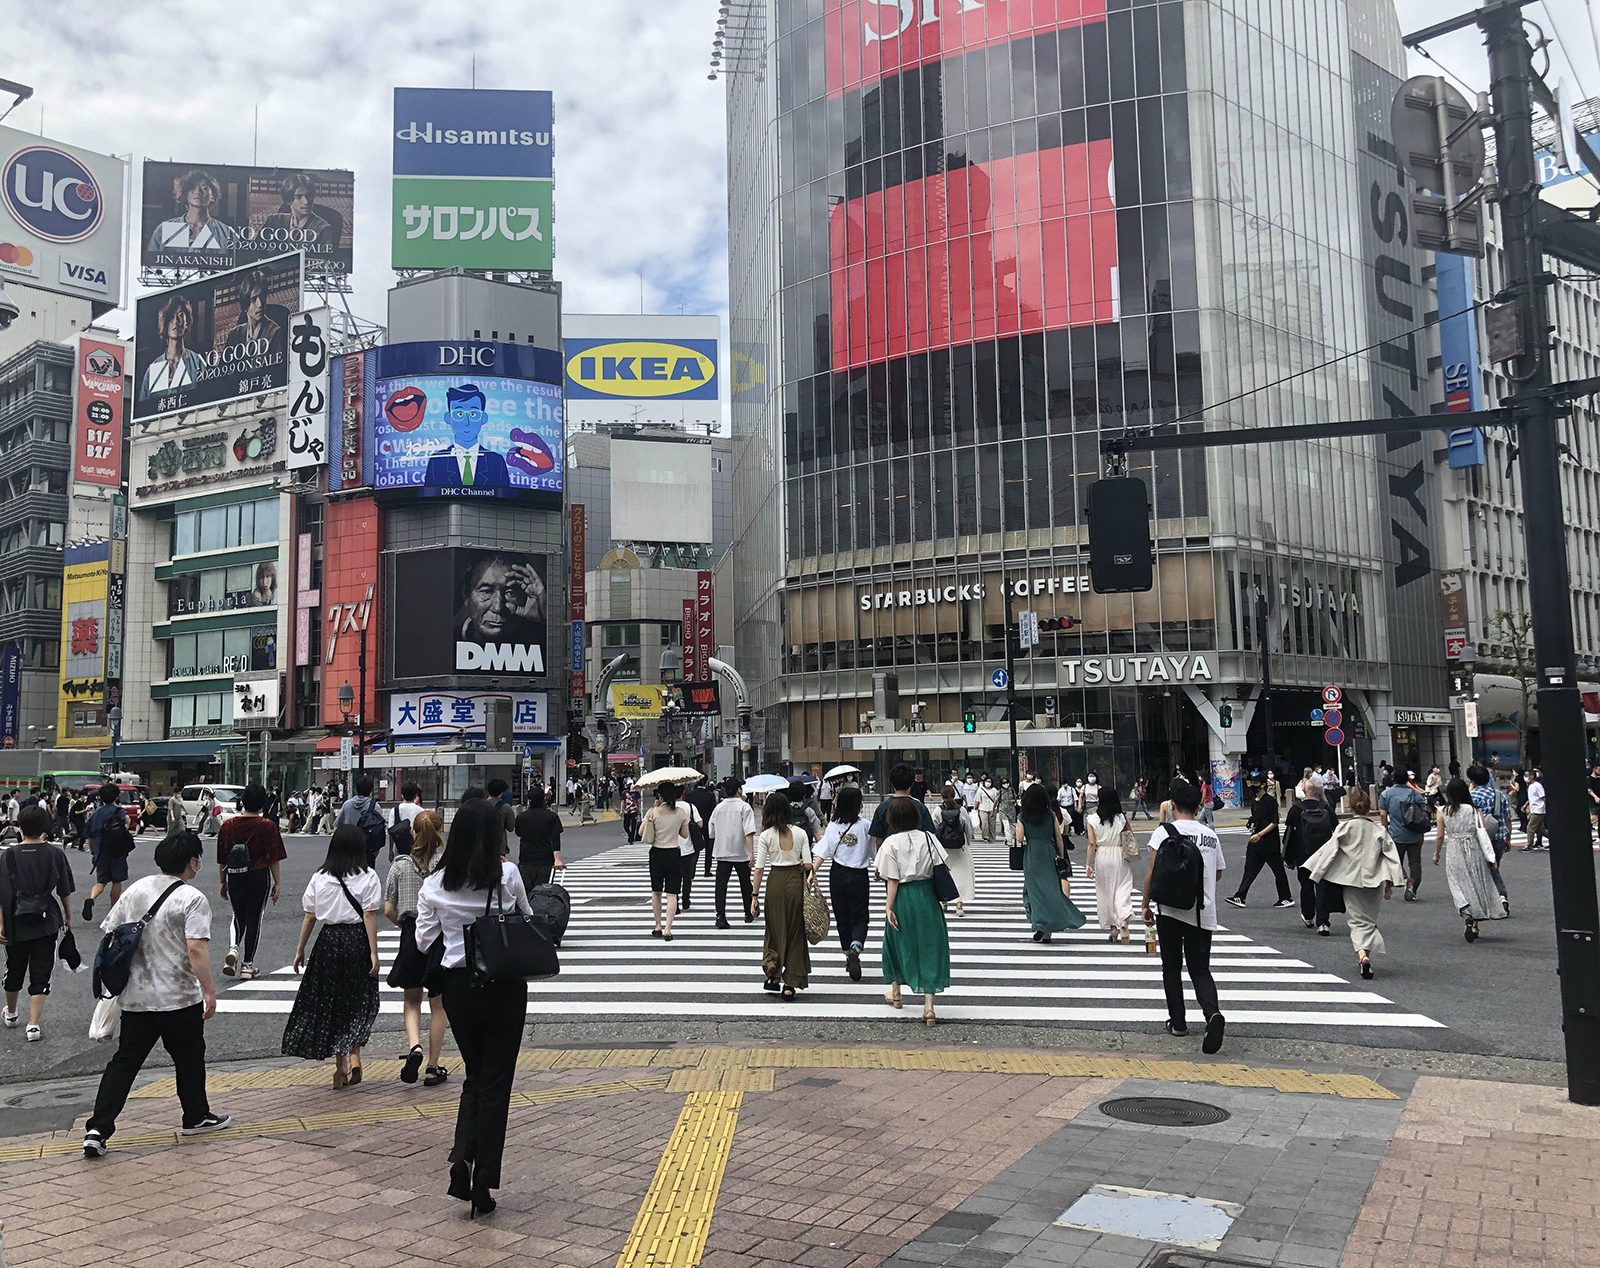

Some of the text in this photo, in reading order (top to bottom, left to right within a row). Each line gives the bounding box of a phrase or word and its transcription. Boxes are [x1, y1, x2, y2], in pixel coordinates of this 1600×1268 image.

[396, 122, 550, 146] Hisamitsu
[227, 226, 317, 242] NO GOOD
[402, 204, 543, 242] サロンパス
[226, 240, 334, 253] 2020.9.9 ON SALE
[155, 255, 233, 266] JIN AKANISHI
[63, 262, 107, 286] VISA
[198, 337, 270, 369] NO GOOD
[438, 346, 496, 367] DHC
[196, 352, 284, 382] 2020.9.9 ON SALE
[580, 357, 706, 381] IKEA
[238, 374, 273, 394] 錦戸亮
[288, 313, 326, 461] もんじゃ
[389, 378, 422, 392] think
[501, 379, 523, 392] the
[526, 385, 562, 399] result
[156, 394, 188, 412] 赤西仁
[485, 396, 562, 424] ee the
[1445, 362, 1474, 448] SEIU
[87, 428, 112, 444] B1F
[540, 425, 560, 438] the
[86, 444, 112, 460] B2F
[441, 487, 495, 496] DHC Channel
[573, 508, 583, 580] クスリのことなら
[67, 571, 95, 580] Matsumoto
[177, 595, 247, 613] Euphoria
[861, 575, 1090, 611] STARBUCKS COFFEE
[1280, 583, 1360, 614] TSUTAYA
[699, 579, 711, 638] カラオケ
[71, 616, 98, 655] 薬
[325, 583, 375, 665] クスリ
[456, 640, 545, 672] DMM
[1449, 640, 1463, 655] 本
[9, 655, 17, 684] MIZUHO
[1062, 655, 1212, 684] TSUTAYA
[397, 699, 538, 726] 大盛堂店
[1395, 710, 1425, 722] TSUTAYA
